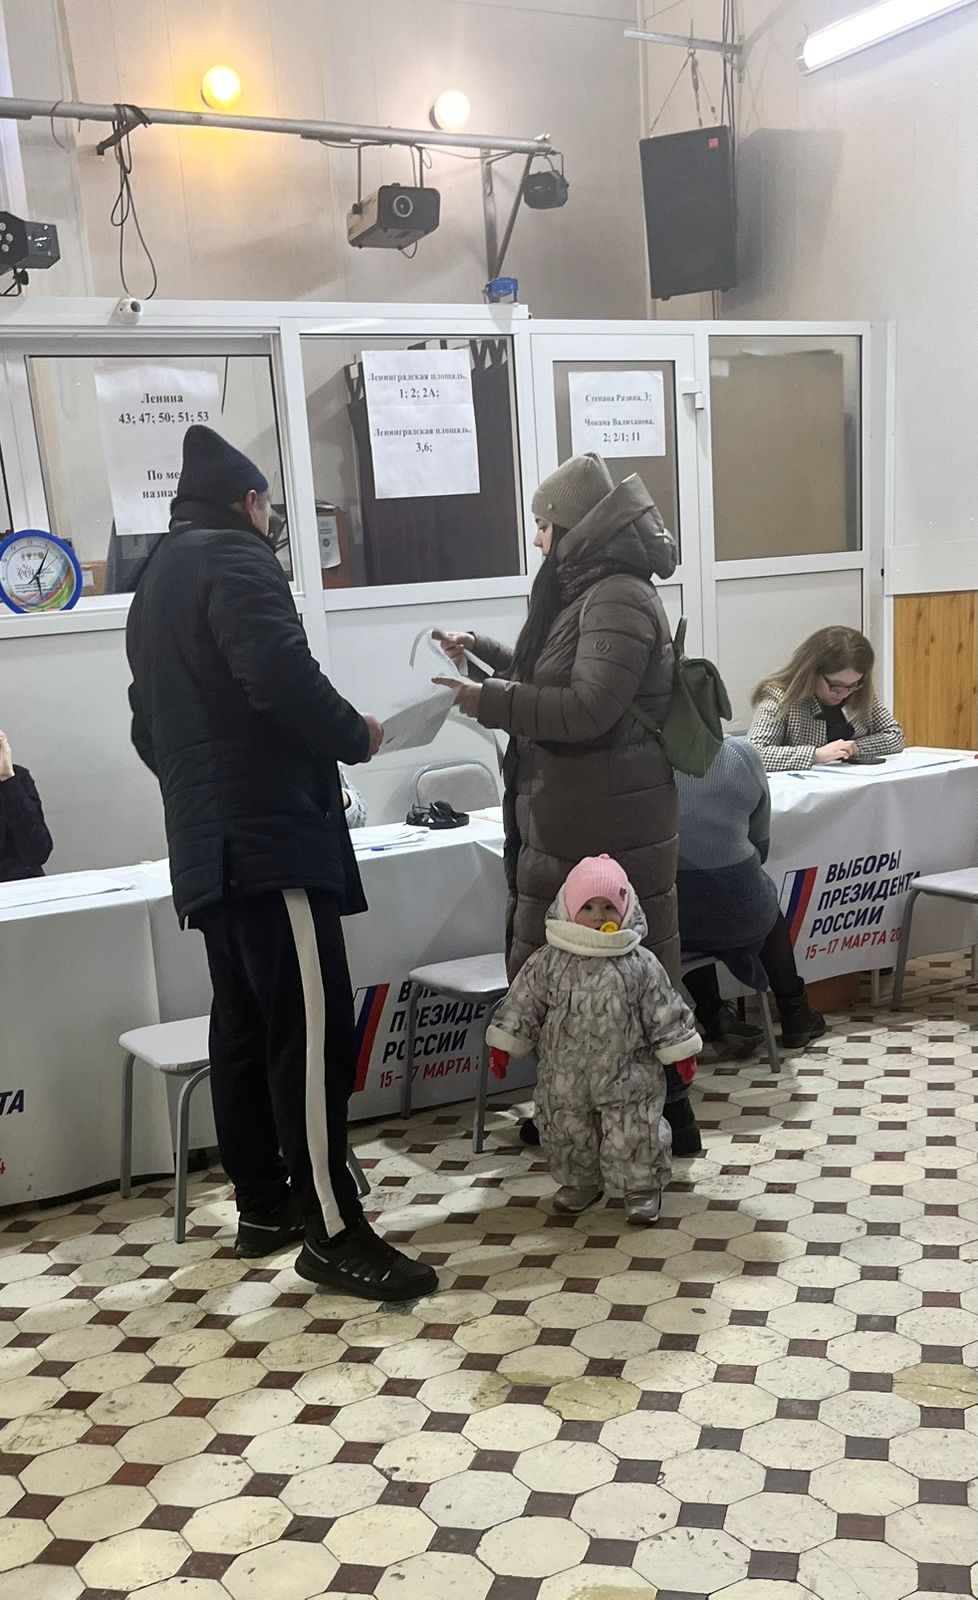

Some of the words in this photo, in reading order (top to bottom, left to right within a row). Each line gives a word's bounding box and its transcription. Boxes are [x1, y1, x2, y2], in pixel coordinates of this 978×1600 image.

[141, 393, 184, 404] Ленина
[400, 388, 408, 399] 1;
[411, 388, 420, 399] 2;
[423, 388, 440, 399] 2А;
[119, 413, 136, 424] 43;
[139, 413, 155, 424] 47;
[158, 412, 175, 424] 50;
[178, 411, 194, 423] 51;
[197, 411, 209, 422] 53
[603, 432, 611, 443] 2;
[631, 431, 640, 441] 11
[416, 442, 433, 453] 3,6;
[147, 469, 163, 481] По
[142, 489, 177, 499] назна
[825, 849, 901, 884] ВЫБОРЫ
[809, 905, 884, 938] РОССИИ
[841, 928, 887, 951] МАРТА
[389, 1001, 486, 1033] ПЕЗИДЕ
[380, 1064, 419, 1088] 15–7
[423, 1056, 471, 1079] МАРТА
